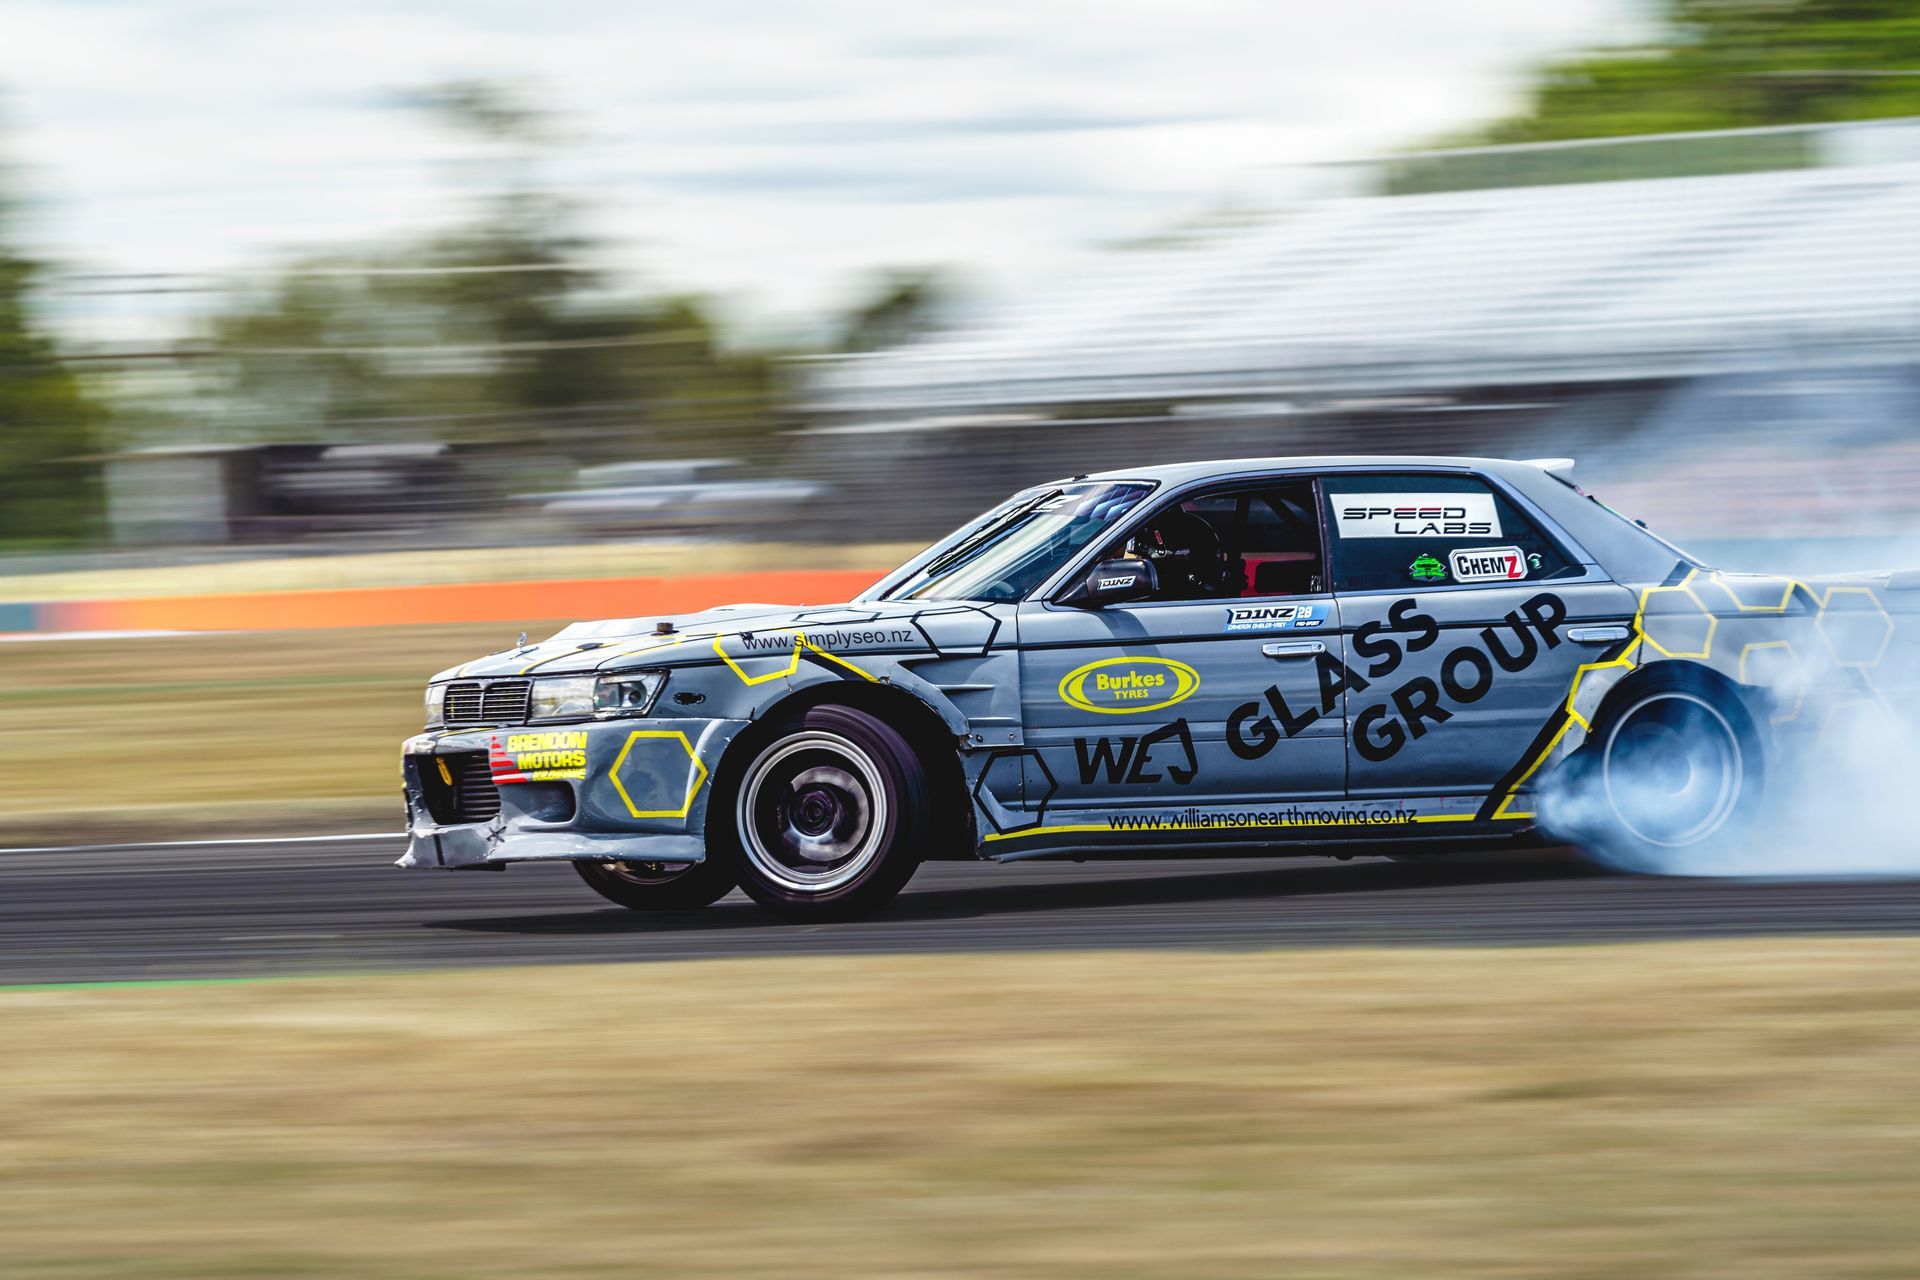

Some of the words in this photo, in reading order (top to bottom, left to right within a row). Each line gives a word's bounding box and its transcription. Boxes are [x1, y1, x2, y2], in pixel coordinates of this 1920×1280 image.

[1343, 507, 1466, 520] SPEED
[1394, 522, 1492, 535] LABS
[1235, 608, 1296, 620] D1NZ
[1297, 606, 1313, 619] 28
[743, 629, 914, 650] www.simplyseo.nz
[1096, 670, 1165, 691] Burkes
[1225, 598, 1440, 761] GLASS
[1353, 592, 1567, 762] GROUP
[1114, 689, 1149, 700] TYRES
[507, 731, 588, 753] BRENDON
[517, 750, 586, 770] MOTORS
[1107, 806, 1418, 830] www.williamsonearthmoving.co.nz
